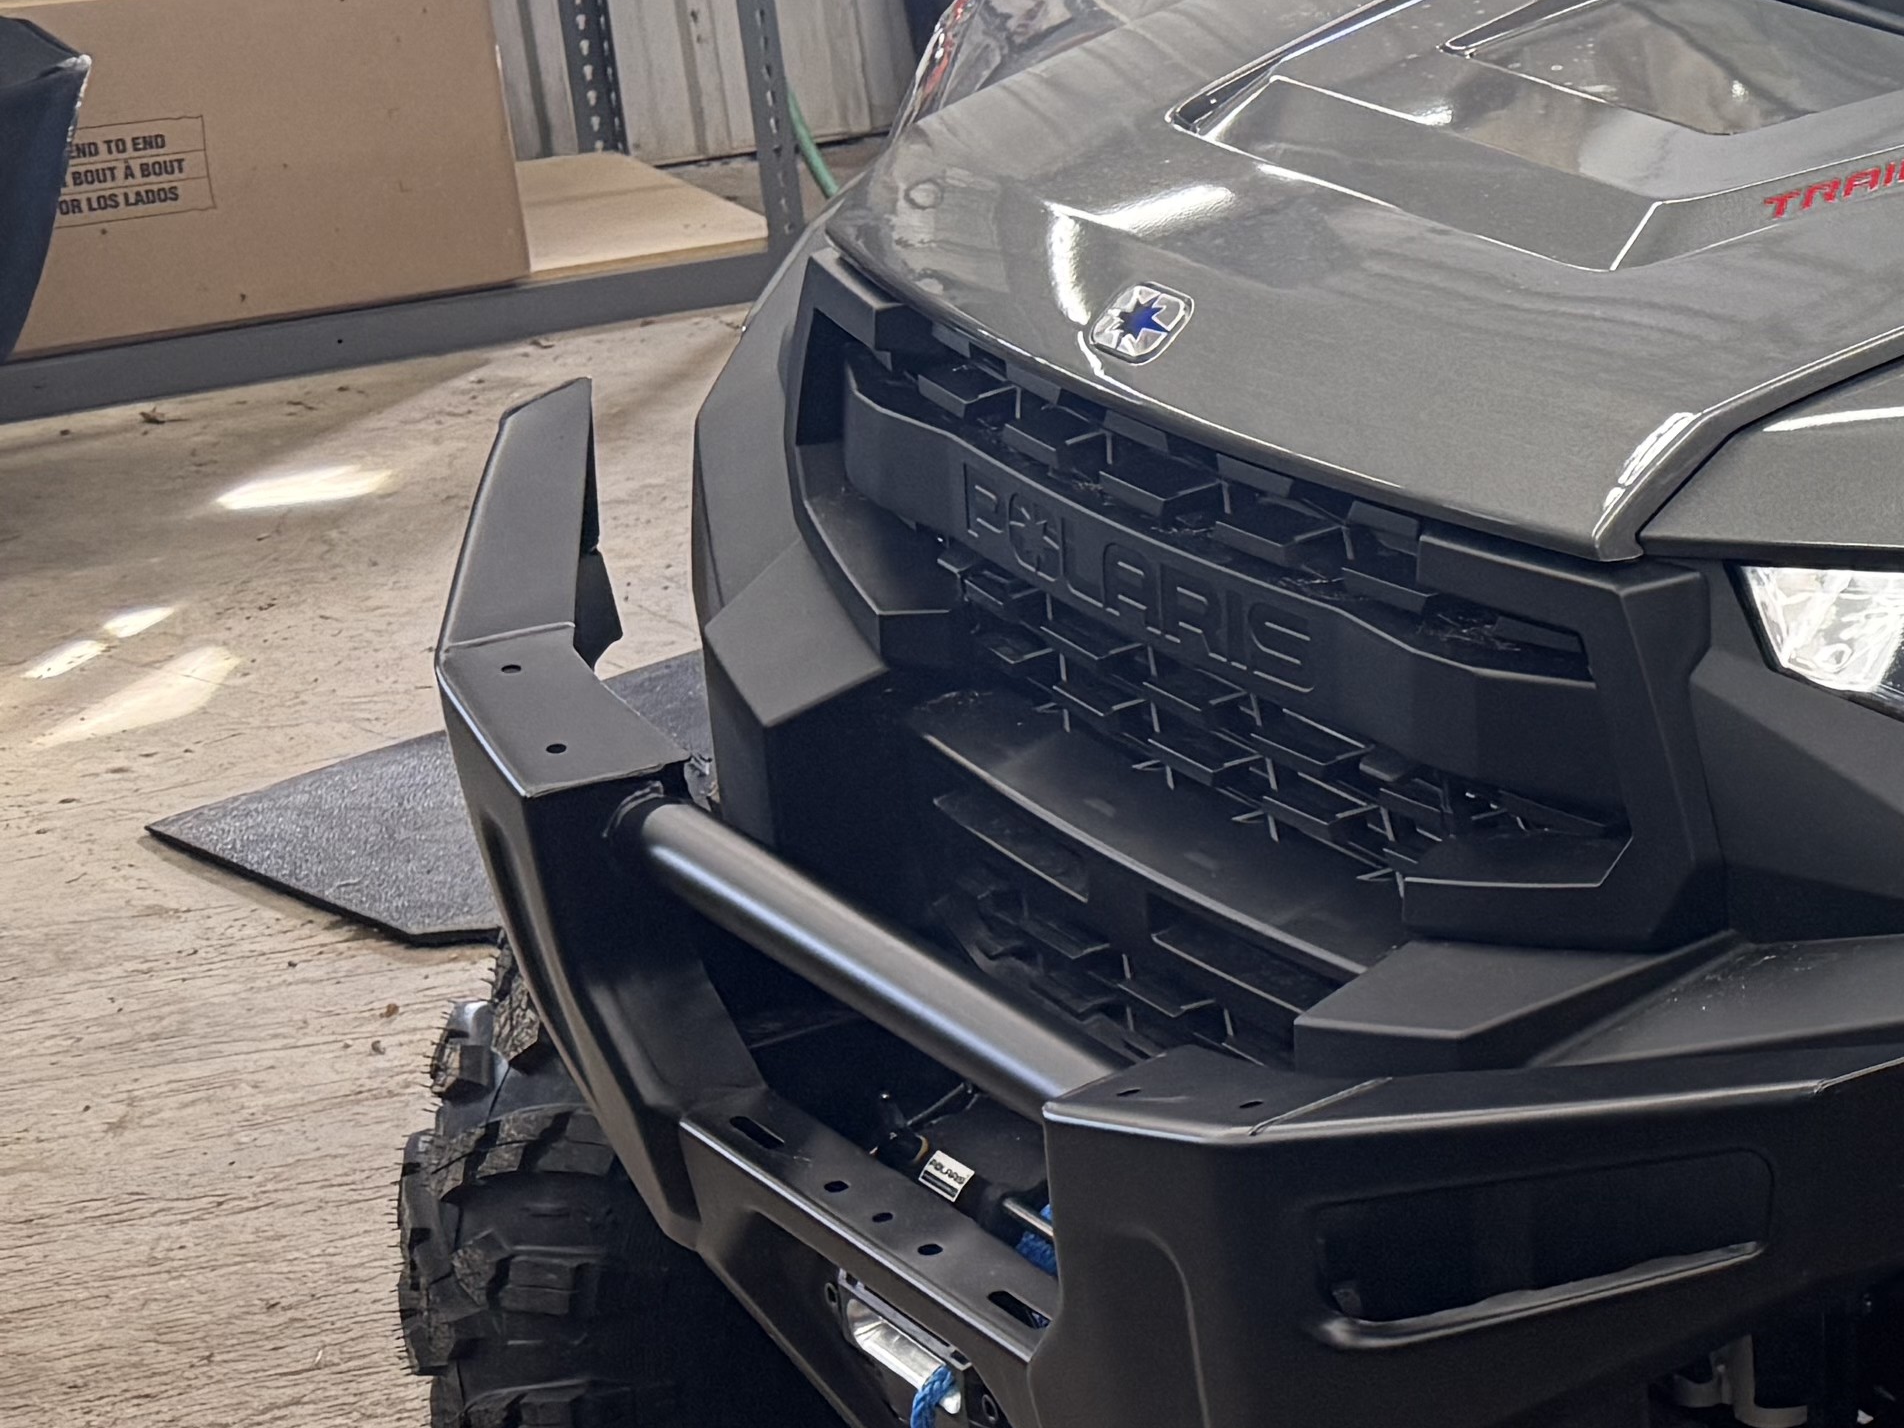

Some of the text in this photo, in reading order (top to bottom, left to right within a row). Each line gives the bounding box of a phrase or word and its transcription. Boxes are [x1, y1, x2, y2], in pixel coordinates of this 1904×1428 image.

[104, 138, 127, 154] TO
[132, 134, 166, 152] END
[72, 166, 117, 186] BOUT
[140, 158, 185, 178] BOUT
[86, 194, 120, 212] LOS
[124, 186, 180, 207] LADOS
[962, 460, 1317, 694] POLARIS
